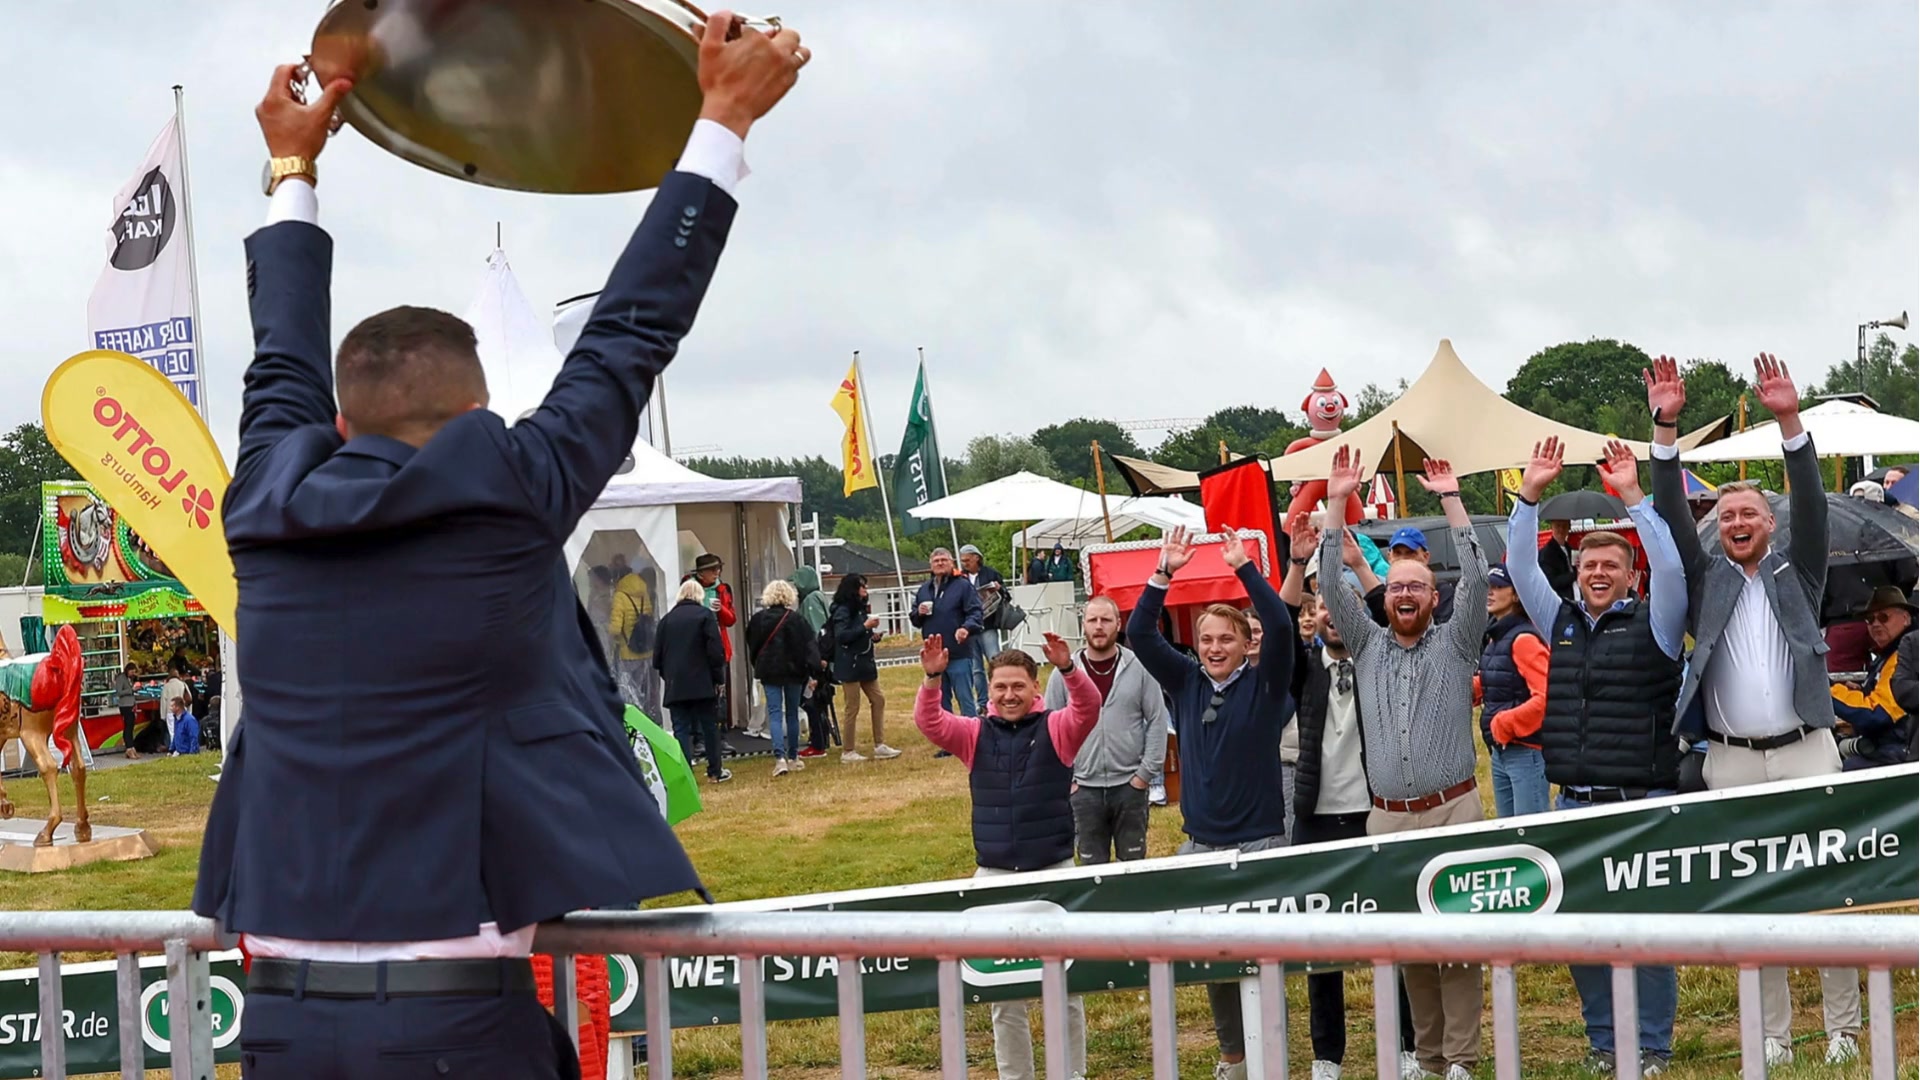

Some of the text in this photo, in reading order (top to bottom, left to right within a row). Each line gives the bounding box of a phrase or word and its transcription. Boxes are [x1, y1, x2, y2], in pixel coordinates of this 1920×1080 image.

[1602, 827, 1900, 892] WETTSTAR.de
[1448, 866, 1517, 894] WETT
[1469, 886, 1531, 913] STAR
